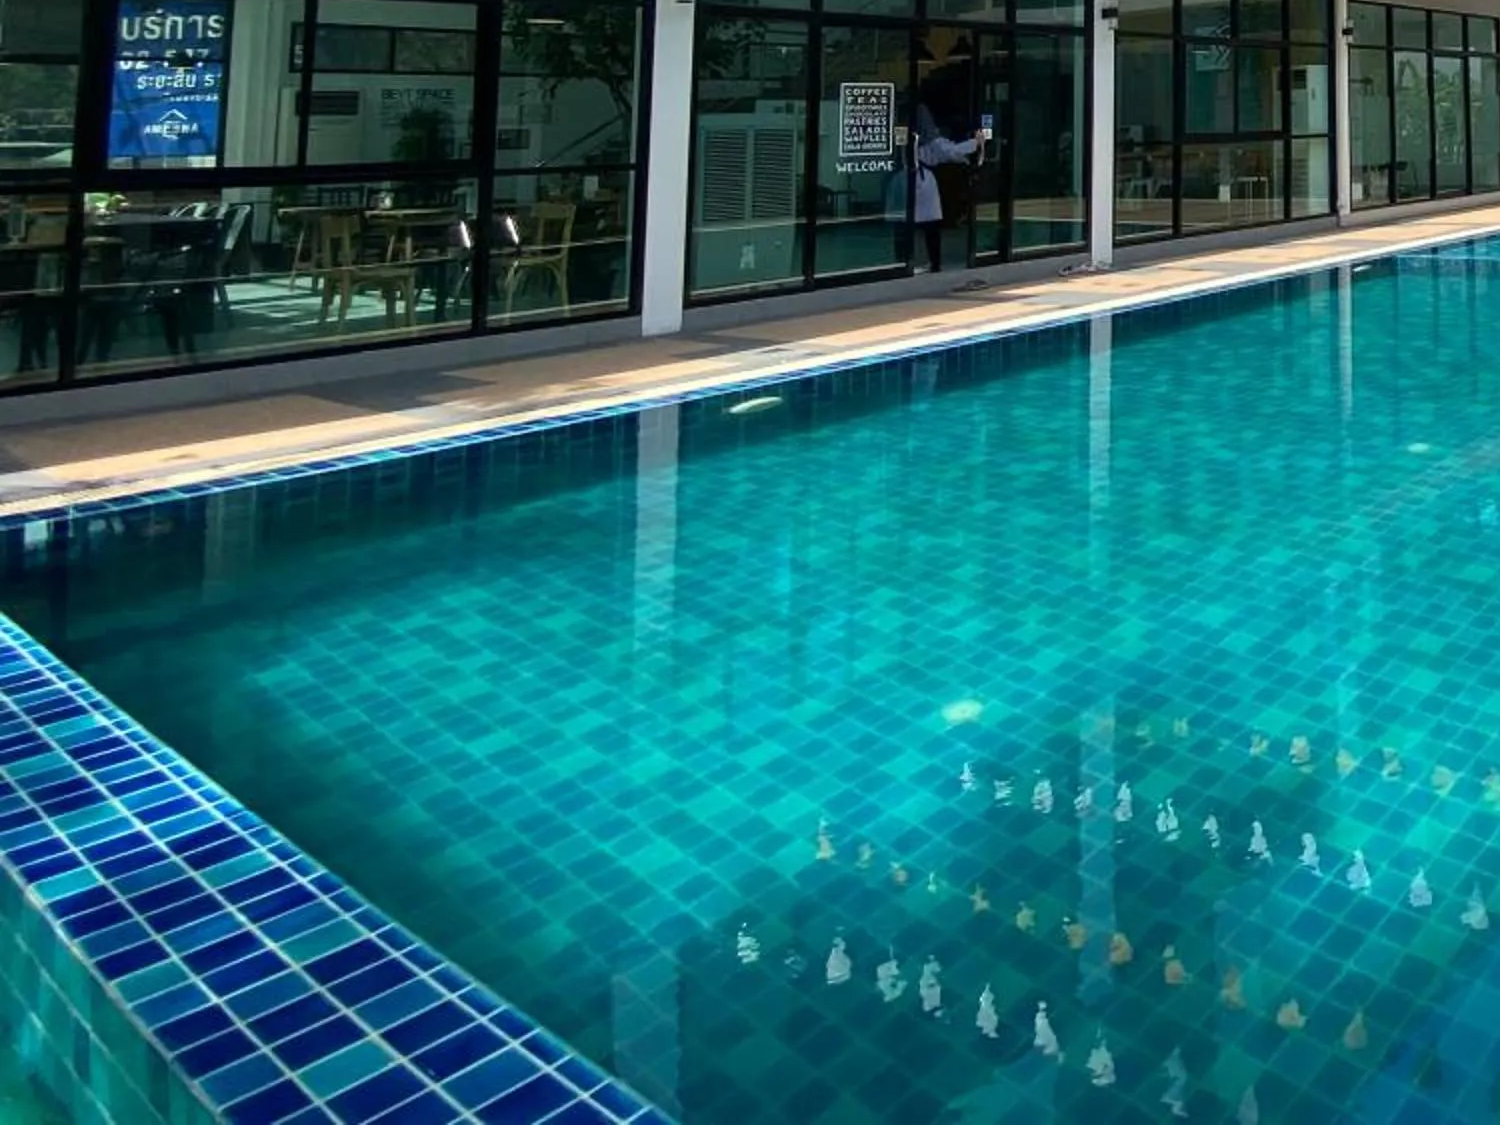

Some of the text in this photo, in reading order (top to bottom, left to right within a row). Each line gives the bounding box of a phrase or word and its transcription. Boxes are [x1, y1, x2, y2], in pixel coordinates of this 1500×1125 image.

[845, 88, 889, 96] COFFEE
[844, 127, 887, 135] SALADS
[836, 160, 895, 173] WELCOME
